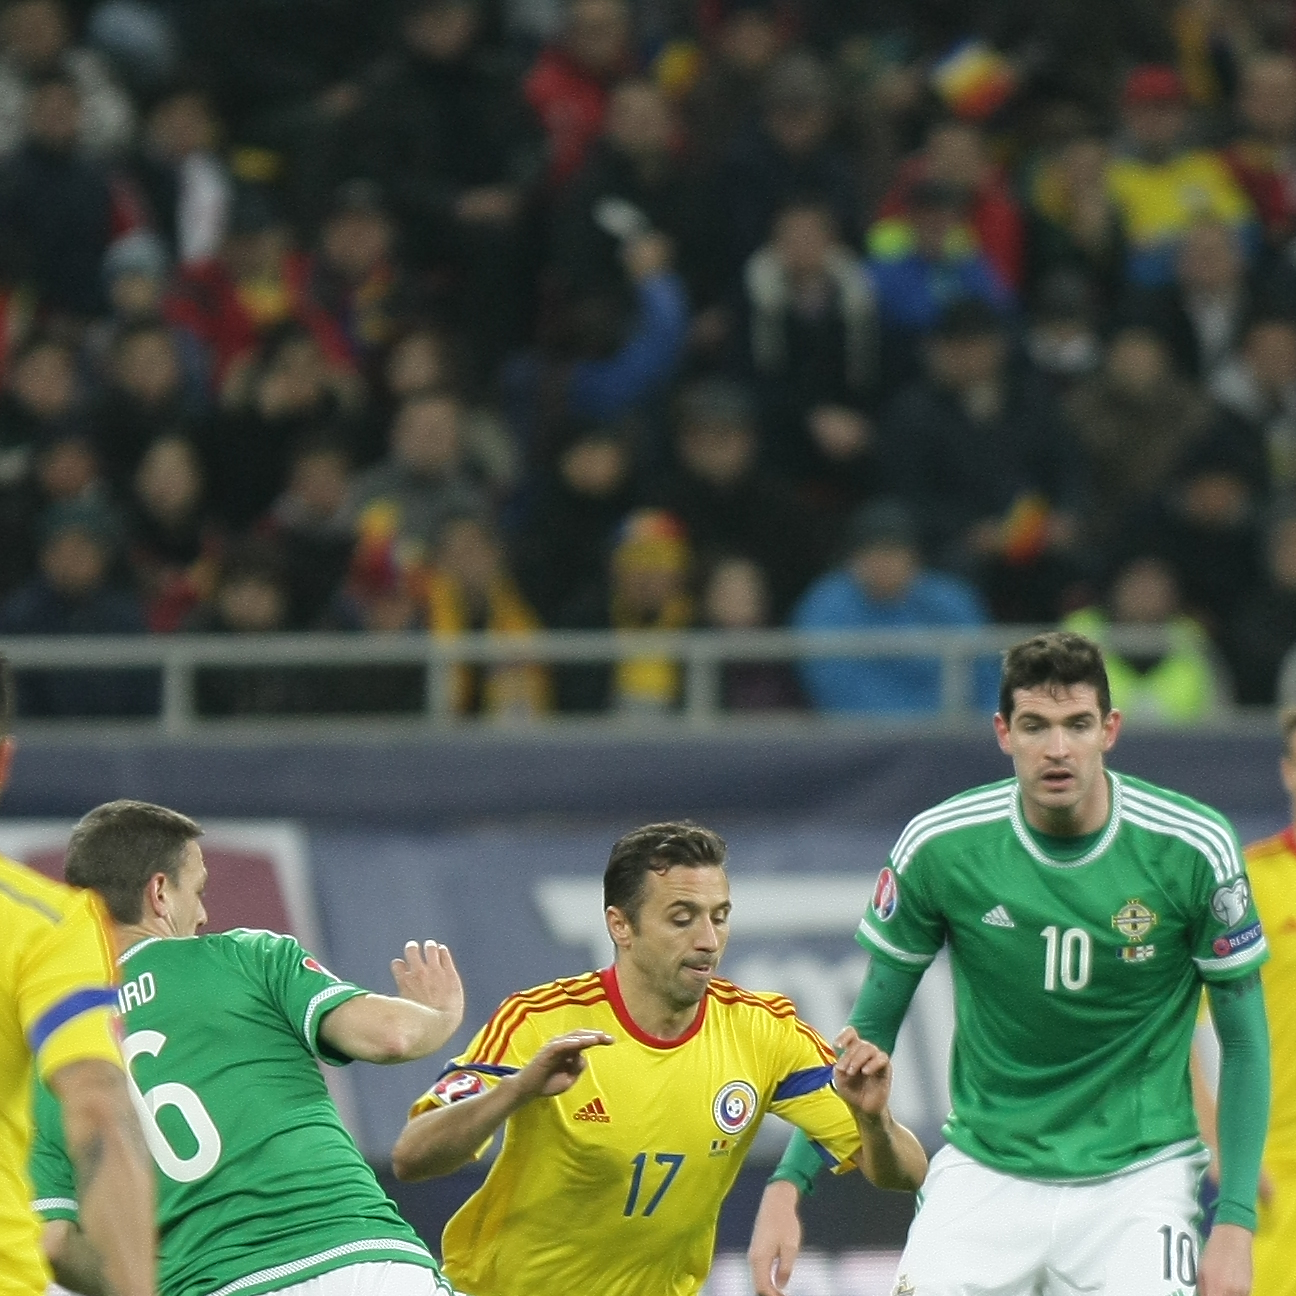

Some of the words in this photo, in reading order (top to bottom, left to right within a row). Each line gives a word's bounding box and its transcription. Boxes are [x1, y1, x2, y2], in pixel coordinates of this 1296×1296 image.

[1039, 925, 1091, 991] 10
[117, 971, 156, 1014] IRD
[122, 1029, 222, 1184] 6
[622, 1152, 687, 1218] 17
[1157, 1223, 1198, 1288] 10
